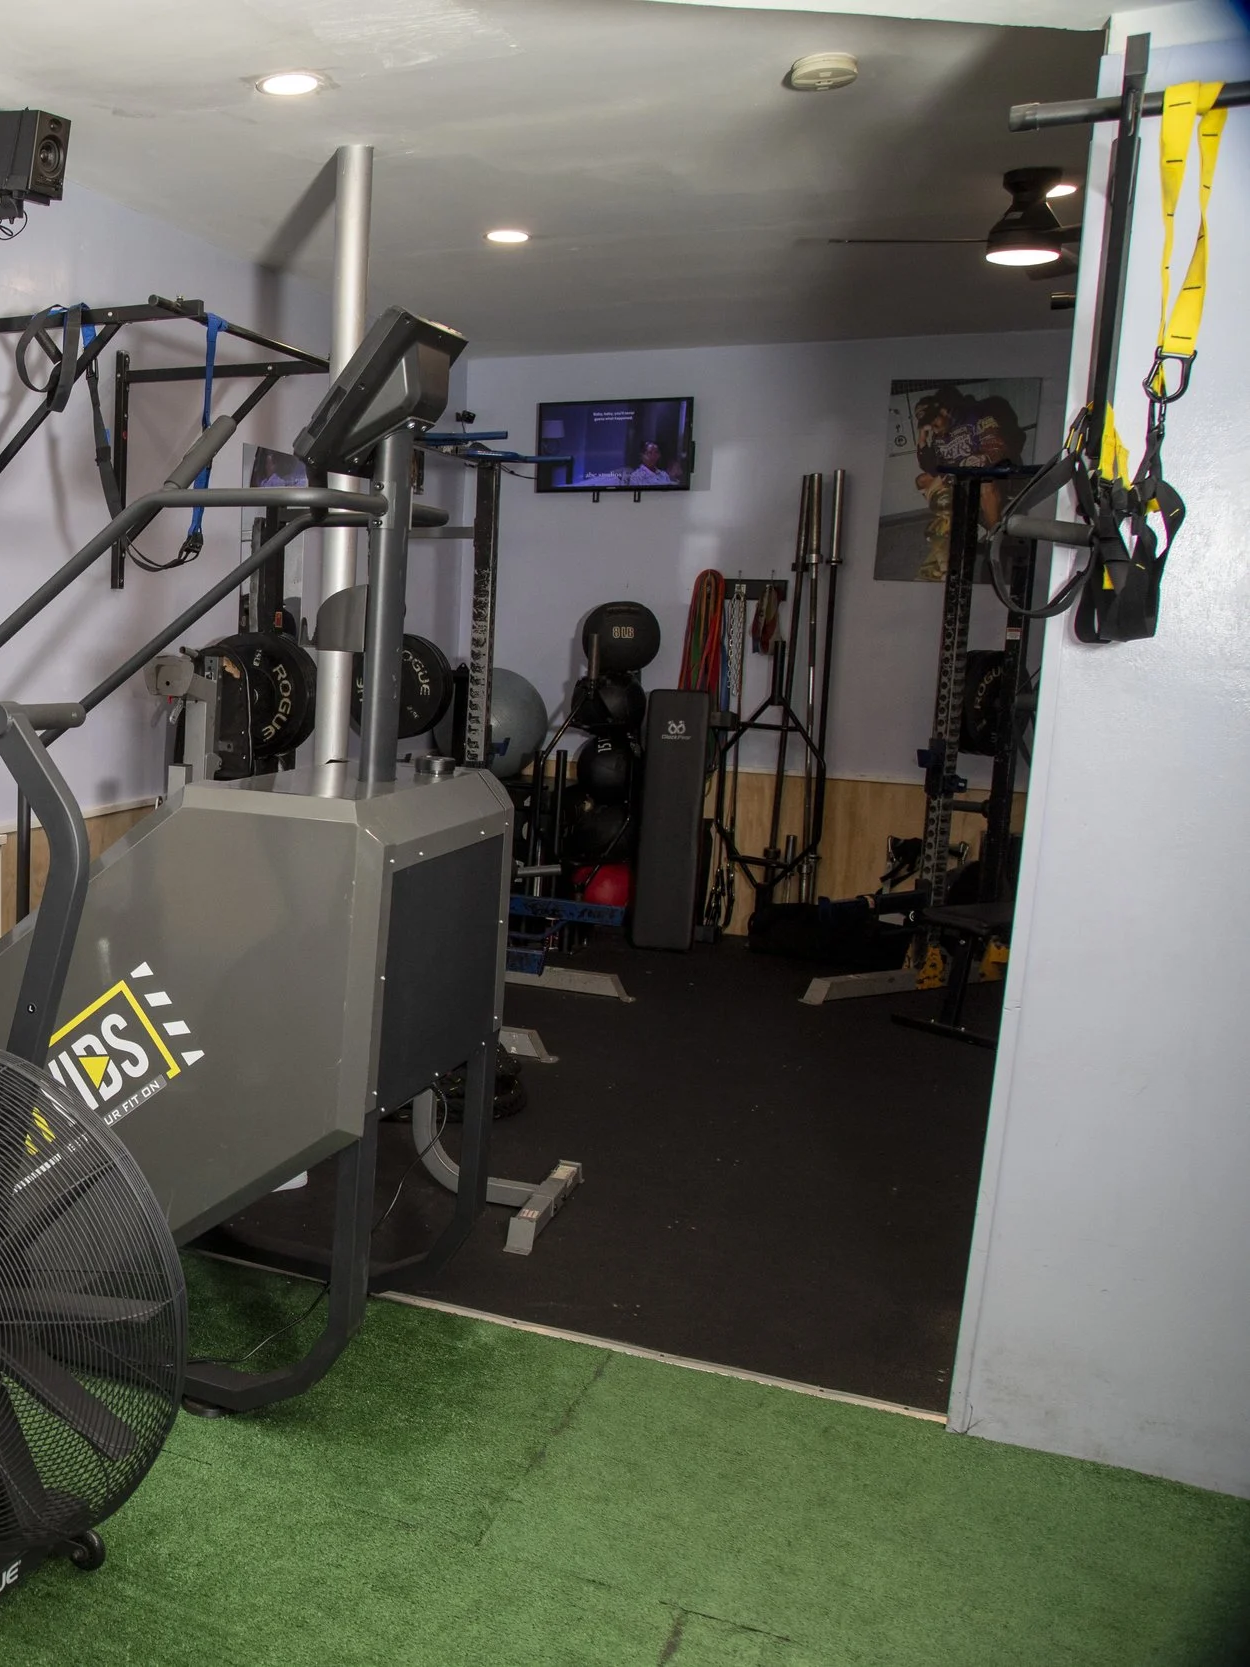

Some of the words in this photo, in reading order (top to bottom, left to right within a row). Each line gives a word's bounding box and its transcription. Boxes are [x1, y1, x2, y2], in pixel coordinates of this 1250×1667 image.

[401, 650, 431, 696] OGUE
[974, 666, 1002, 709] ROGU
[262, 663, 292, 742] ROGUE
[123, 1096, 139, 1112] FIT
[141, 1080, 160, 1098] ON
